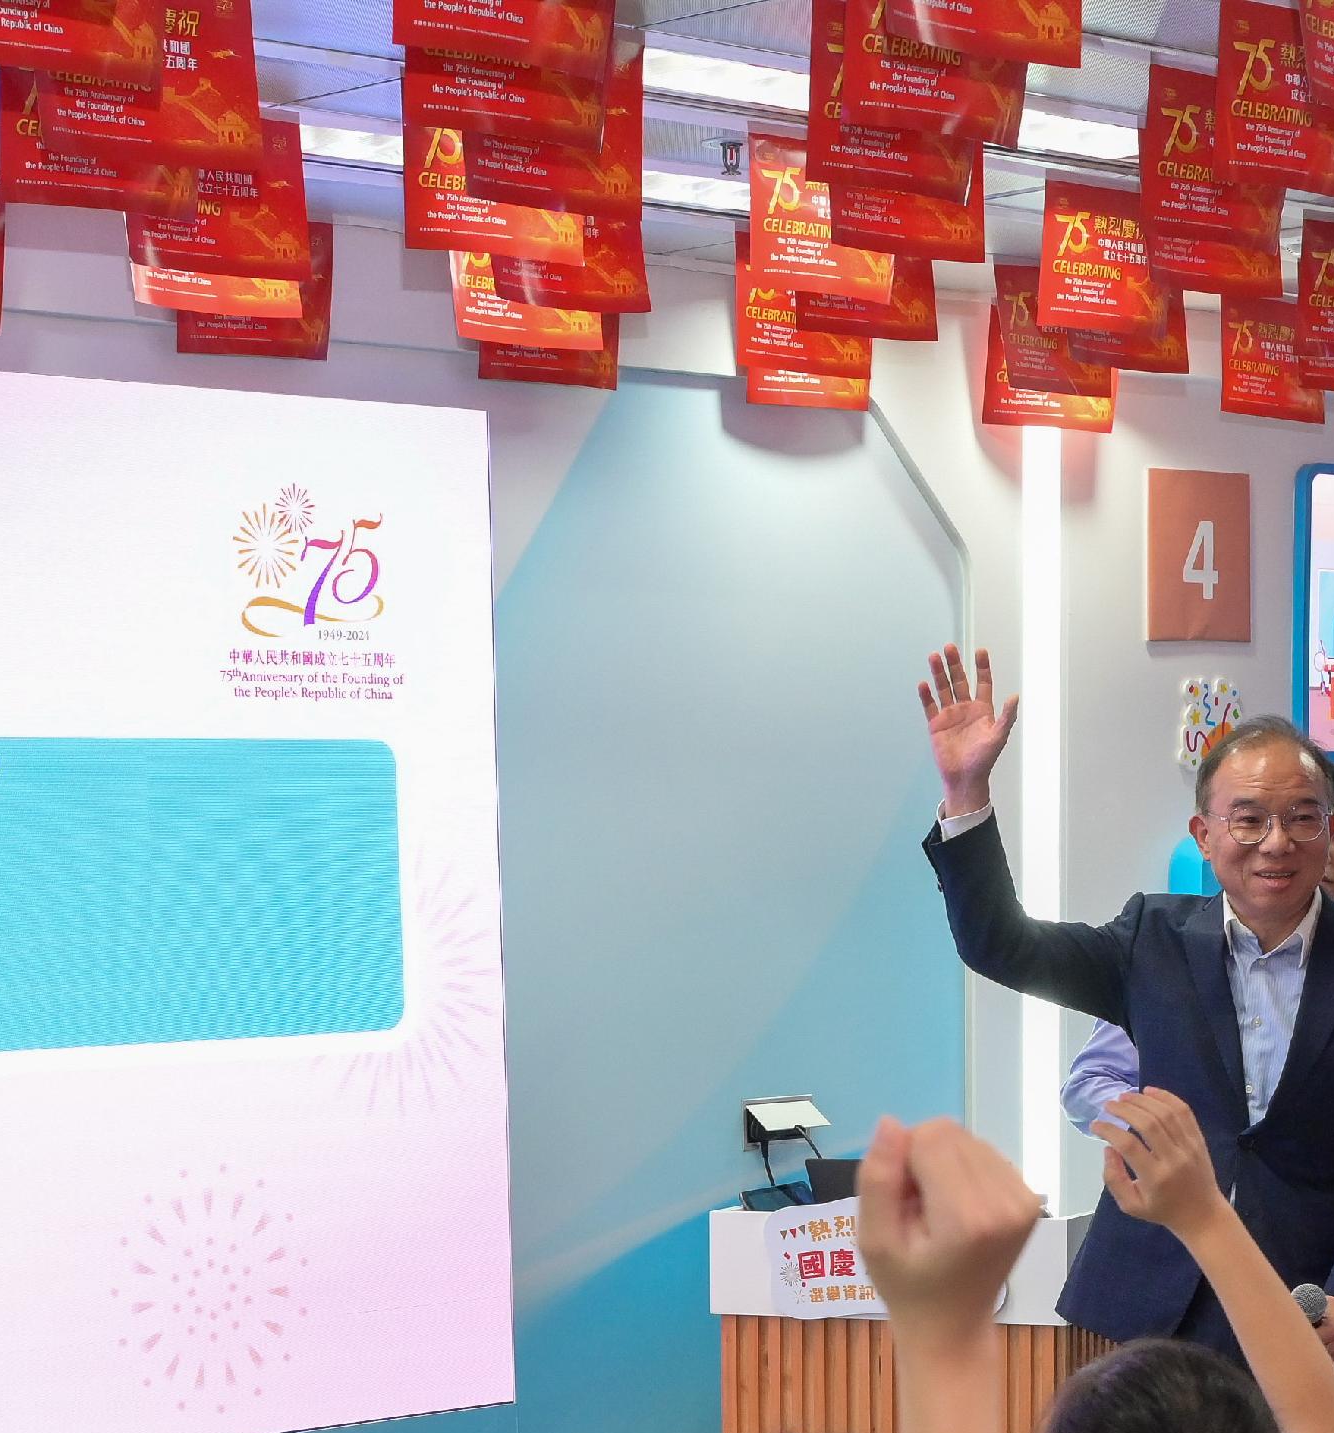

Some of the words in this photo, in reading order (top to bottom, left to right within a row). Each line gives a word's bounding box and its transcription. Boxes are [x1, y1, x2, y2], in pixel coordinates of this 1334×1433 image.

[424, 1, 436, 10] the
[438, 2, 467, 13] People's
[469, 6, 496, 18] Republic
[498, 11, 505, 19] of
[506, 12, 524, 24] China
[1233, 39, 1275, 96] 75
[1231, 99, 1313, 127] CELEBRATING
[1161, 104, 1201, 157] 75
[761, 166, 801, 215] 75
[1055, 212, 1091, 257] 75
[1053, 260, 1121, 280] CELEBRATING
[1229, 320, 1255, 356] 75
[1229, 358, 1279, 376] CELEBRATING
[301, 512, 383, 627] 75
[1182, 520, 1219, 600] 4
[229, 649, 396, 668] 中華人民共和國成立七十五周年
[234, 685, 251, 697] the
[255, 686, 297, 701] People's
[301, 687, 346, 702] Republic
[350, 687, 361, 700] of
[365, 687, 393, 700] China
[308, 672, 318, 683] of
[321, 672, 338, 683] the
[342, 673, 390, 687] Founding
[392, 673, 404, 685] of
